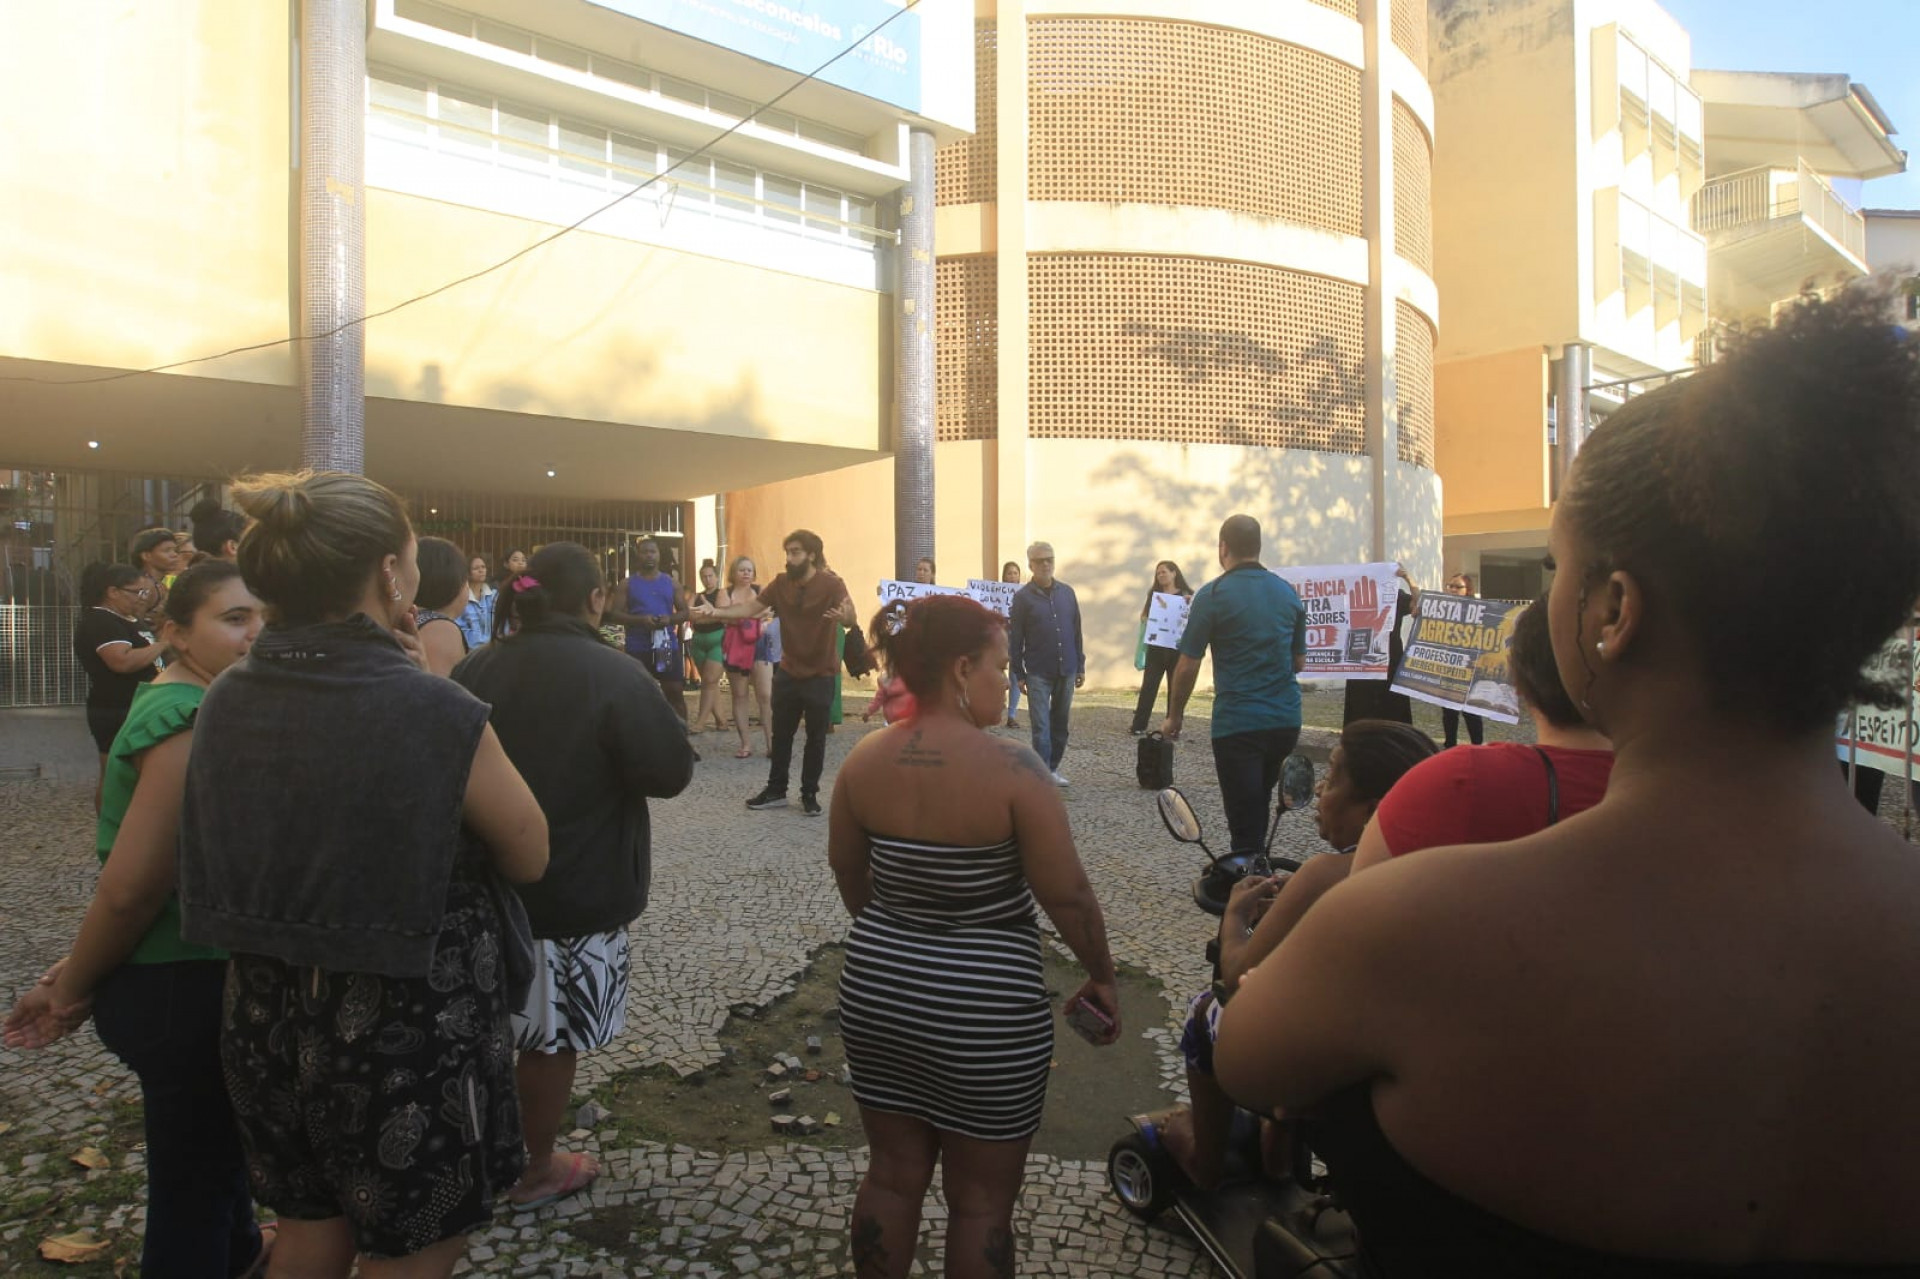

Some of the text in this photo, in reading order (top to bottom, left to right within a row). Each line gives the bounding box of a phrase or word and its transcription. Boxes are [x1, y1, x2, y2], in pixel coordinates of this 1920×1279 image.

[874, 34, 908, 65] Rio
[887, 583, 917, 598] PAZ
[1302, 598, 1331, 613] TRA
[1421, 598, 1463, 621] BASTA
[1465, 603, 1487, 624] DE
[1306, 611, 1349, 625] SSORES,
[1306, 628, 1326, 646] O!
[1417, 618, 1502, 651] AGRESSÃO!
[1413, 647, 1464, 667] PROFESSOR
